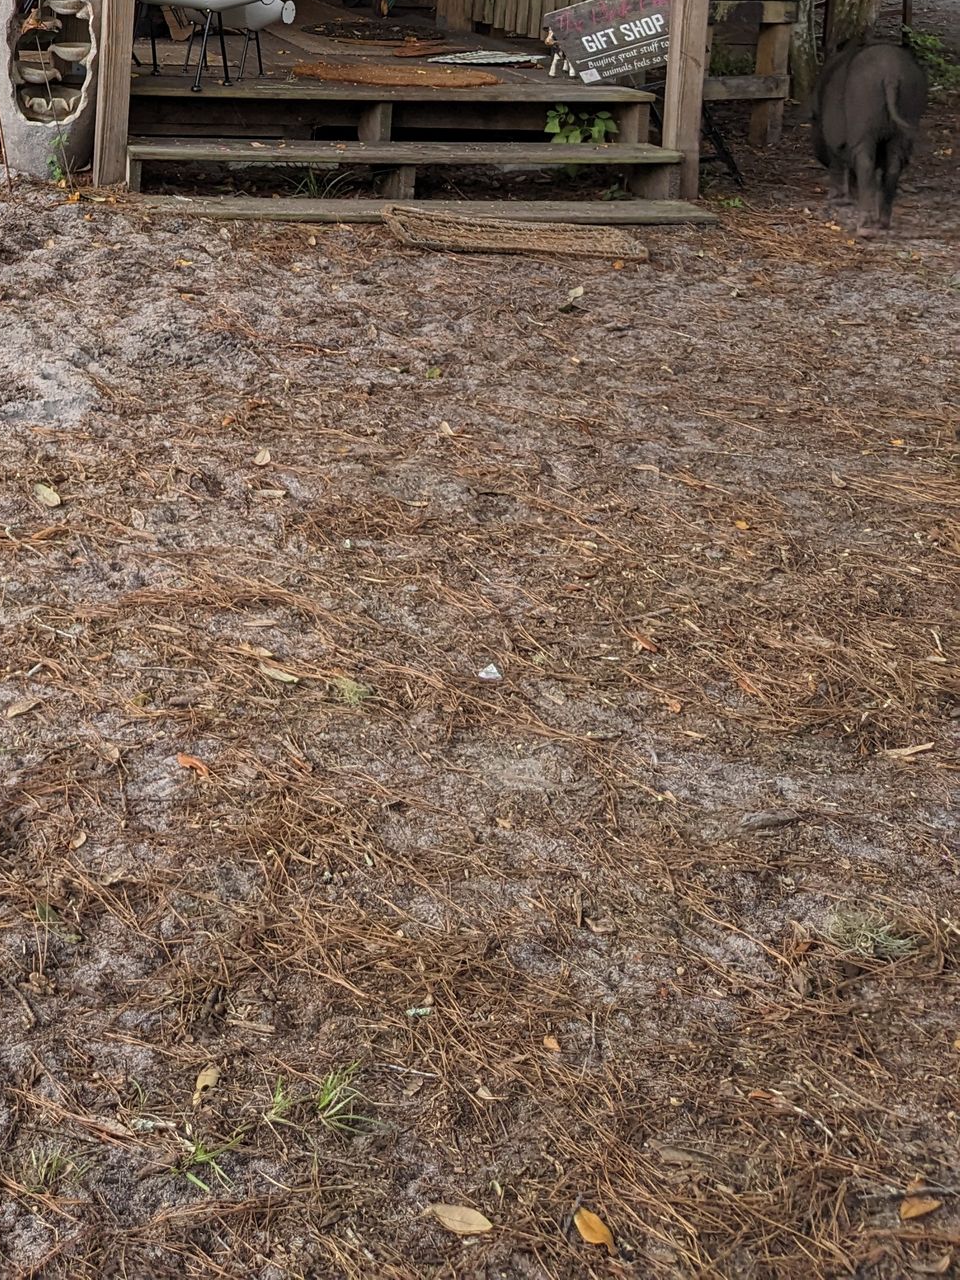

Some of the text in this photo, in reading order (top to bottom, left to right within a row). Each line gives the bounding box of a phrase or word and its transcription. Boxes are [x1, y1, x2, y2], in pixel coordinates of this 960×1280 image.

[581, 13, 665, 53] GIFT SHOP
[588, 55, 617, 69] Buying
[617, 49, 638, 62] great
[640, 41, 660, 55] stuff
[602, 62, 633, 78] animals
[633, 57, 651, 70] feels
[652, 56, 661, 65] so
